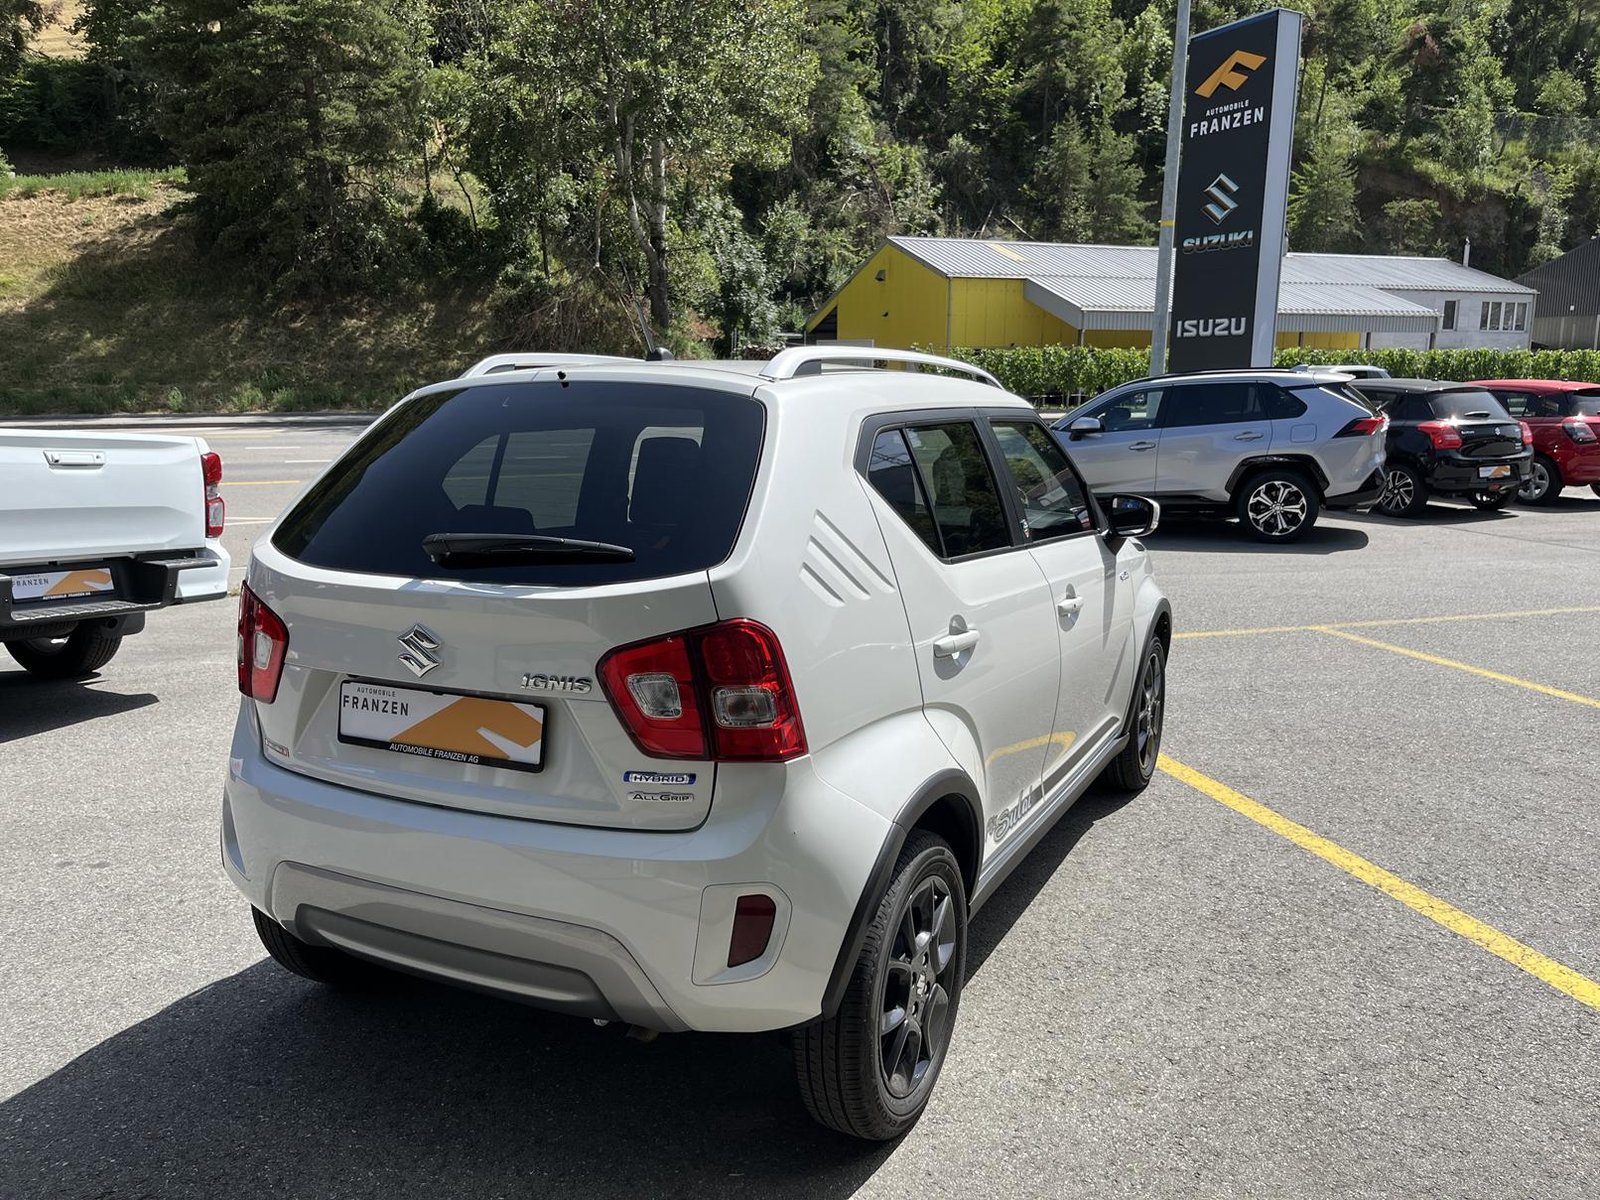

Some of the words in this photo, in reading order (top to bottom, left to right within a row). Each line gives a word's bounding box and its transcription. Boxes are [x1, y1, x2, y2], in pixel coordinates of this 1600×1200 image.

[1205, 99, 1249, 117] AUTOMOBILE
[1190, 106, 1264, 138] FRANZEN
[1183, 230, 1254, 255] SUZUKI
[1176, 317, 1246, 338] ISUZU
[356, 686, 396, 698] AUTOMOBILE
[520, 672, 593, 694] IGNIS
[342, 695, 410, 716] FRANZEN
[389, 742, 434, 757] AUTOMOBILE
[434, 749, 467, 762] FRANZEN
[467, 754, 479, 764] AG
[632, 774, 687, 783] HYBRID
